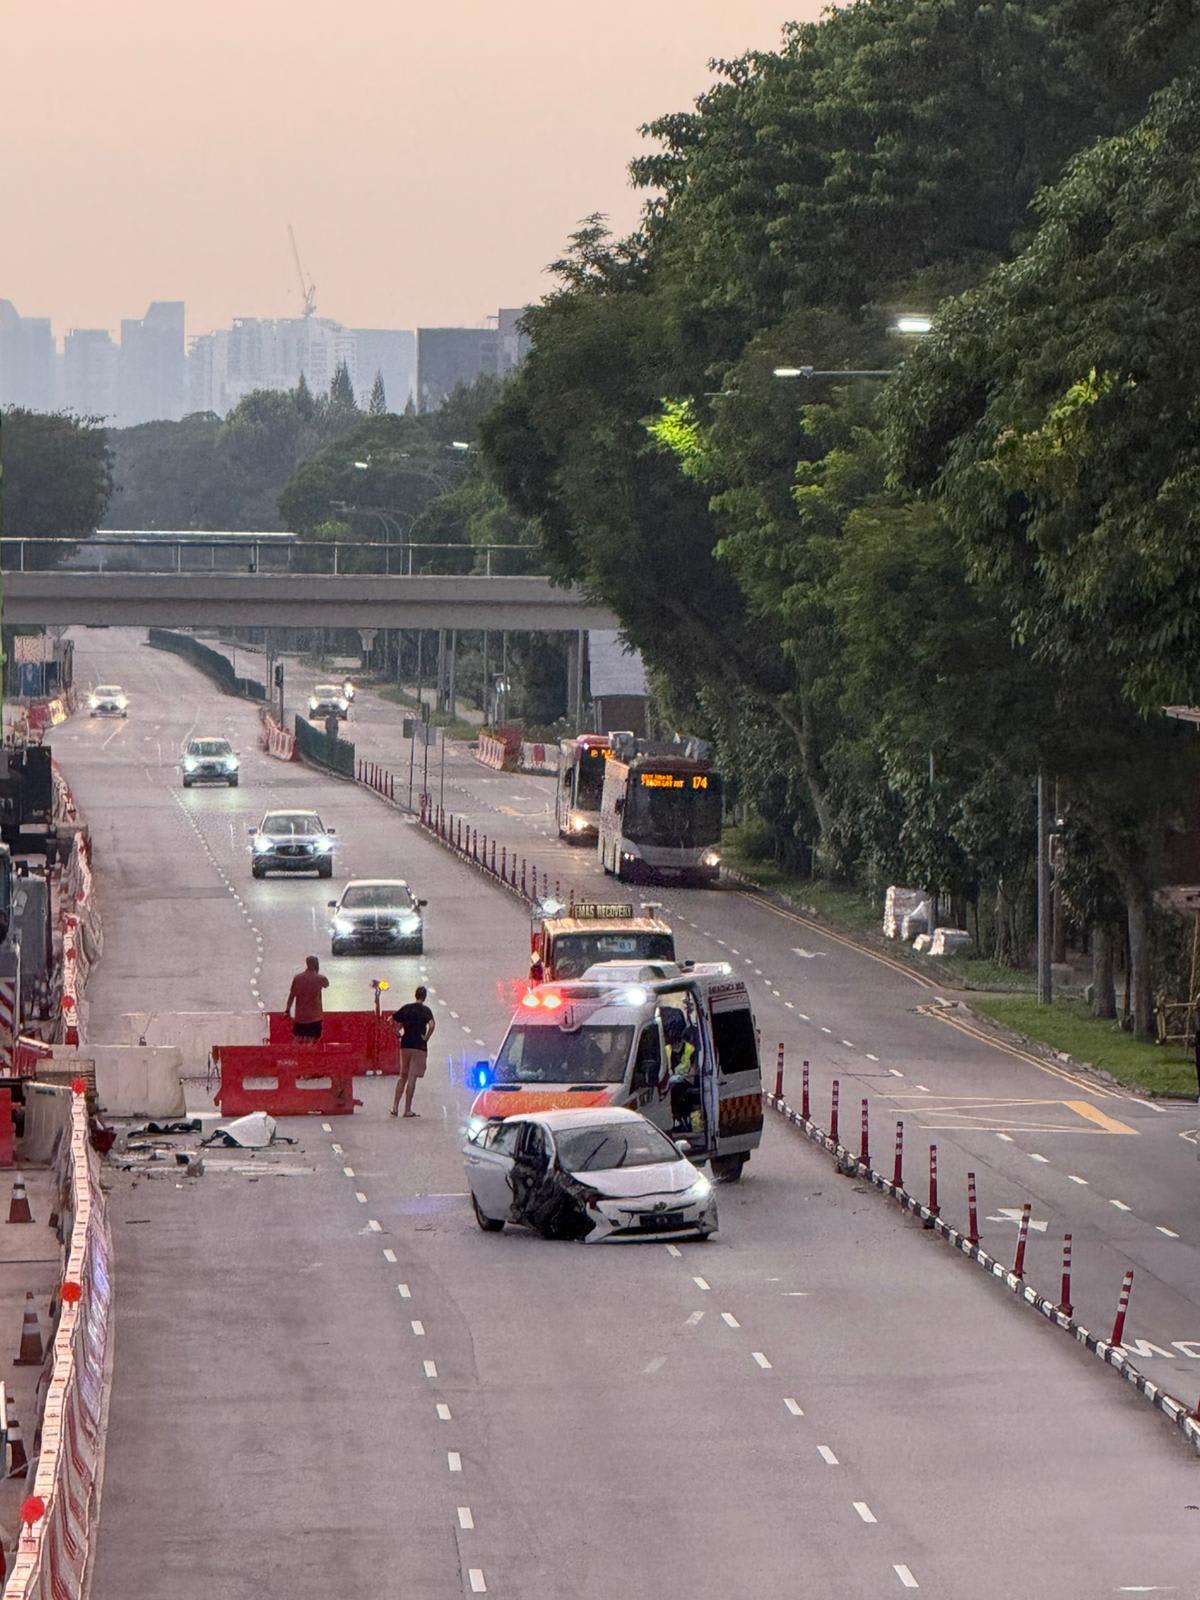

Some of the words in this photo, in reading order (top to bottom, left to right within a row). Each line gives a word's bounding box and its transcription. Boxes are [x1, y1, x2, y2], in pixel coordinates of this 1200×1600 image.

[692, 776, 708, 789] 174
[575, 905, 595, 918] EMAS
[596, 905, 632, 918] RECOVERY
